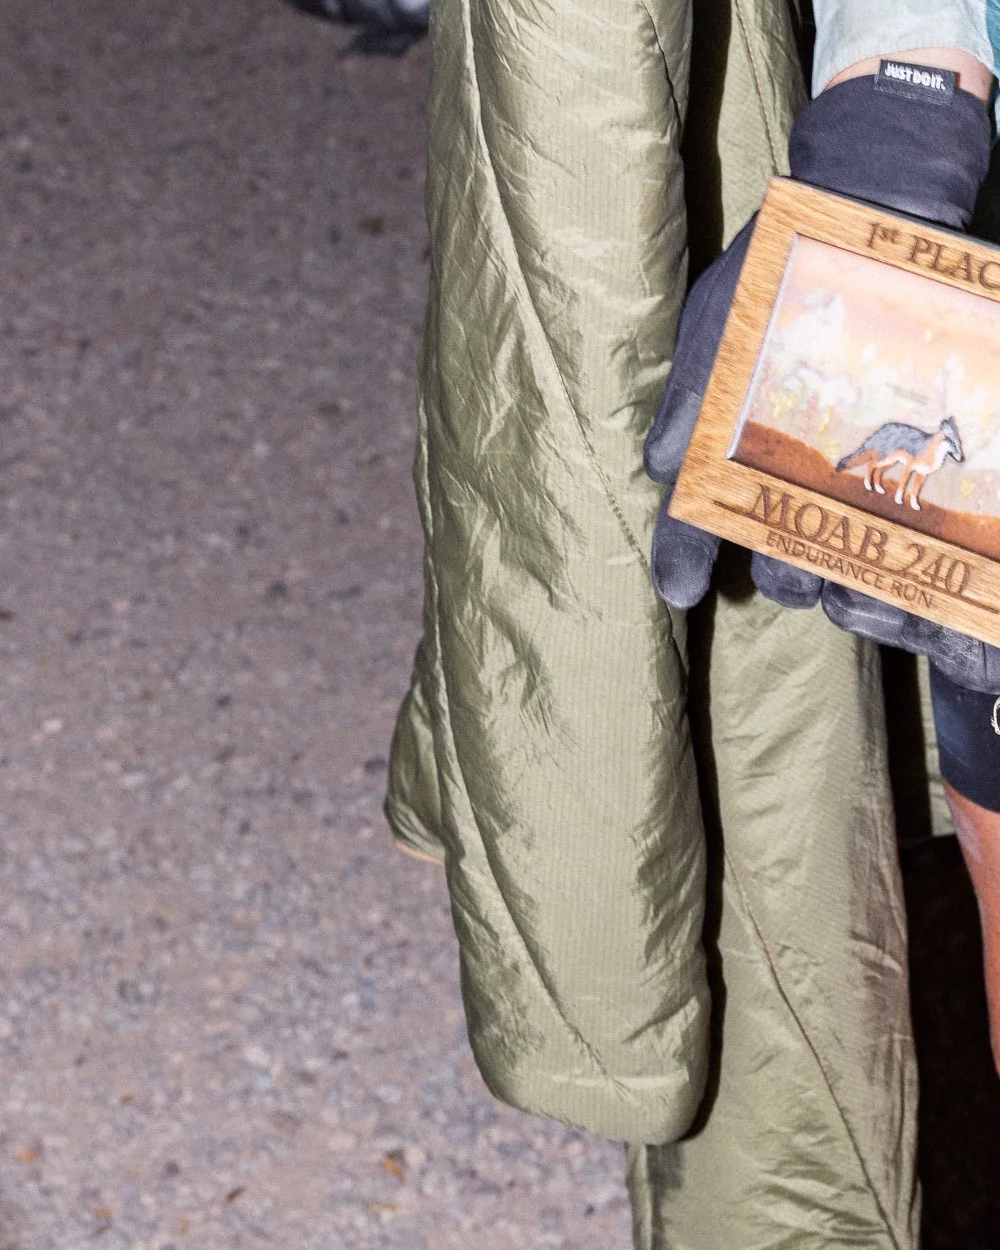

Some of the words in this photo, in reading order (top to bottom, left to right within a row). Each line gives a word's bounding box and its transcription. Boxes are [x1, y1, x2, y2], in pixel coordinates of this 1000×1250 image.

[885, 62, 913, 82] JUST
[912, 69, 931, 86] DO
[866, 222, 900, 249] 1st
[750, 483, 888, 566] MOAB
[899, 542, 972, 599] 240
[766, 530, 887, 589] ENDURANCE
[890, 579, 934, 608] RUN
